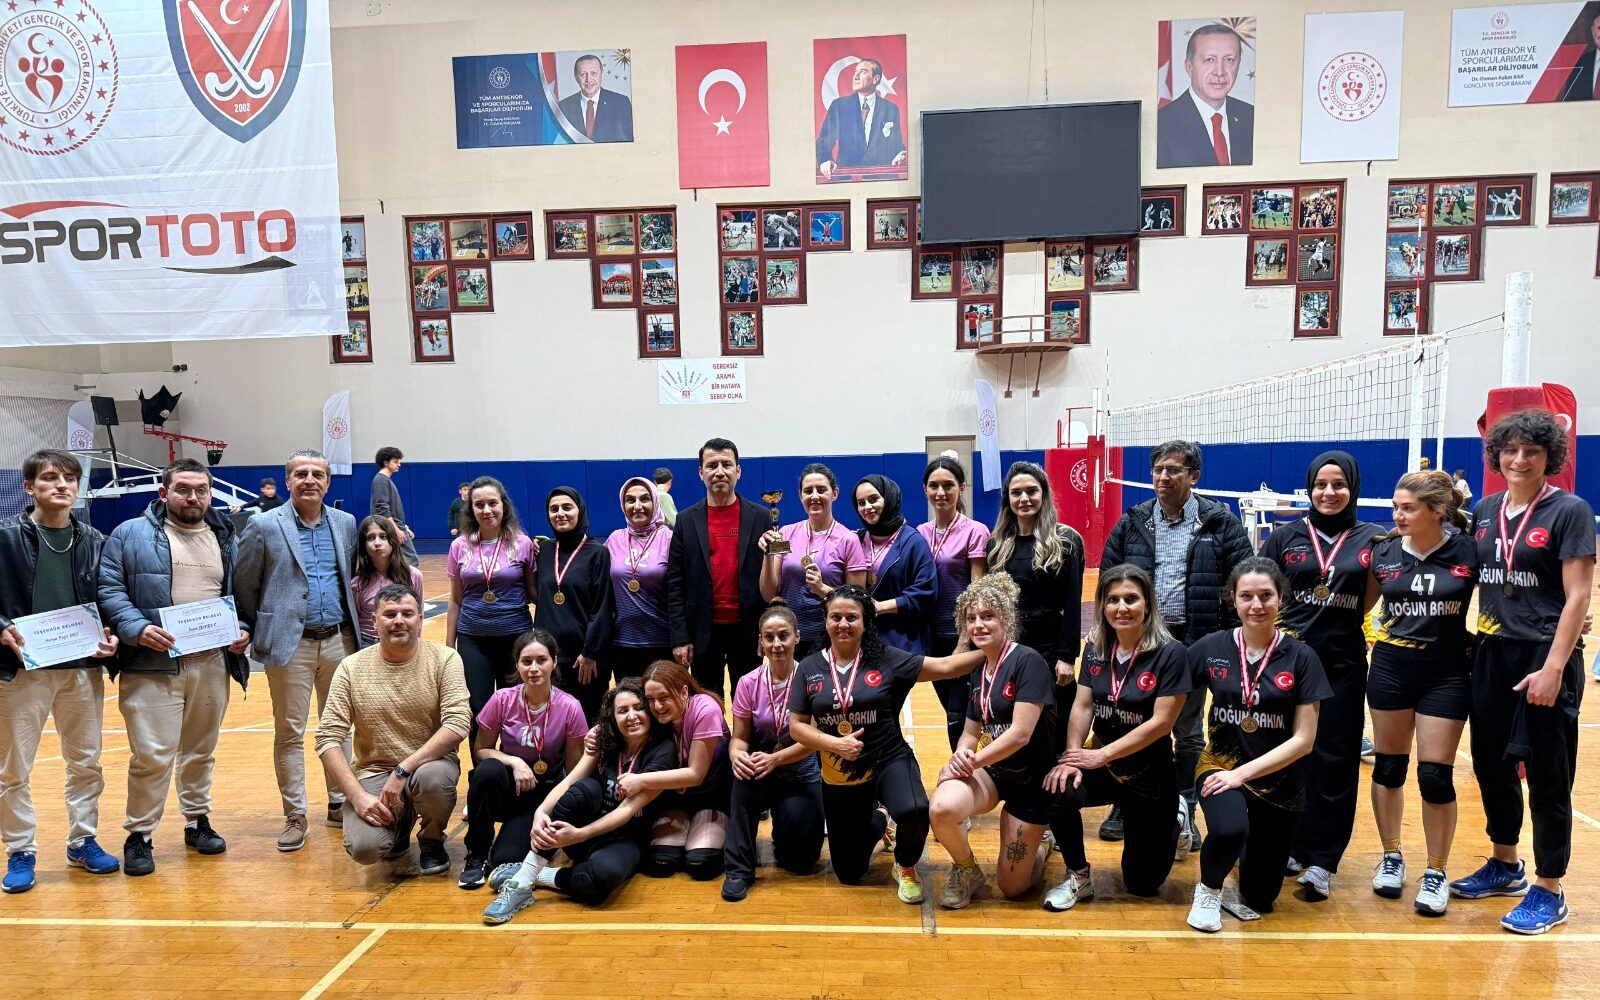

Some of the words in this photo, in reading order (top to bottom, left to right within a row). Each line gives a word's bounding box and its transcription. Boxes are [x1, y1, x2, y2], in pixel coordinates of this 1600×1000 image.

[24, 14, 65, 30] GENÇLİK
[66, 26, 77, 40] VE
[75, 39, 90, 68] SPOR
[1460, 48, 1479, 57] TÜM
[1480, 45, 1526, 56] ANTRENÖR
[1527, 45, 1537, 54] VE
[1462, 54, 1535, 66] SPORCULARIMIZA
[1458, 65, 1498, 74] BAŞARILAR
[1498, 63, 1539, 72] DİLİYORUM
[58, 72, 91, 121] BAKANLIĞI
[234, 102, 251, 113] 2002
[712, 361, 739, 370] GEREKSİZ
[711, 382, 720, 390] BİR
[1410, 573, 1436, 596] 47
[1326, 592, 1359, 610] BAKIM
[848, 709, 877, 726] BAKIM
